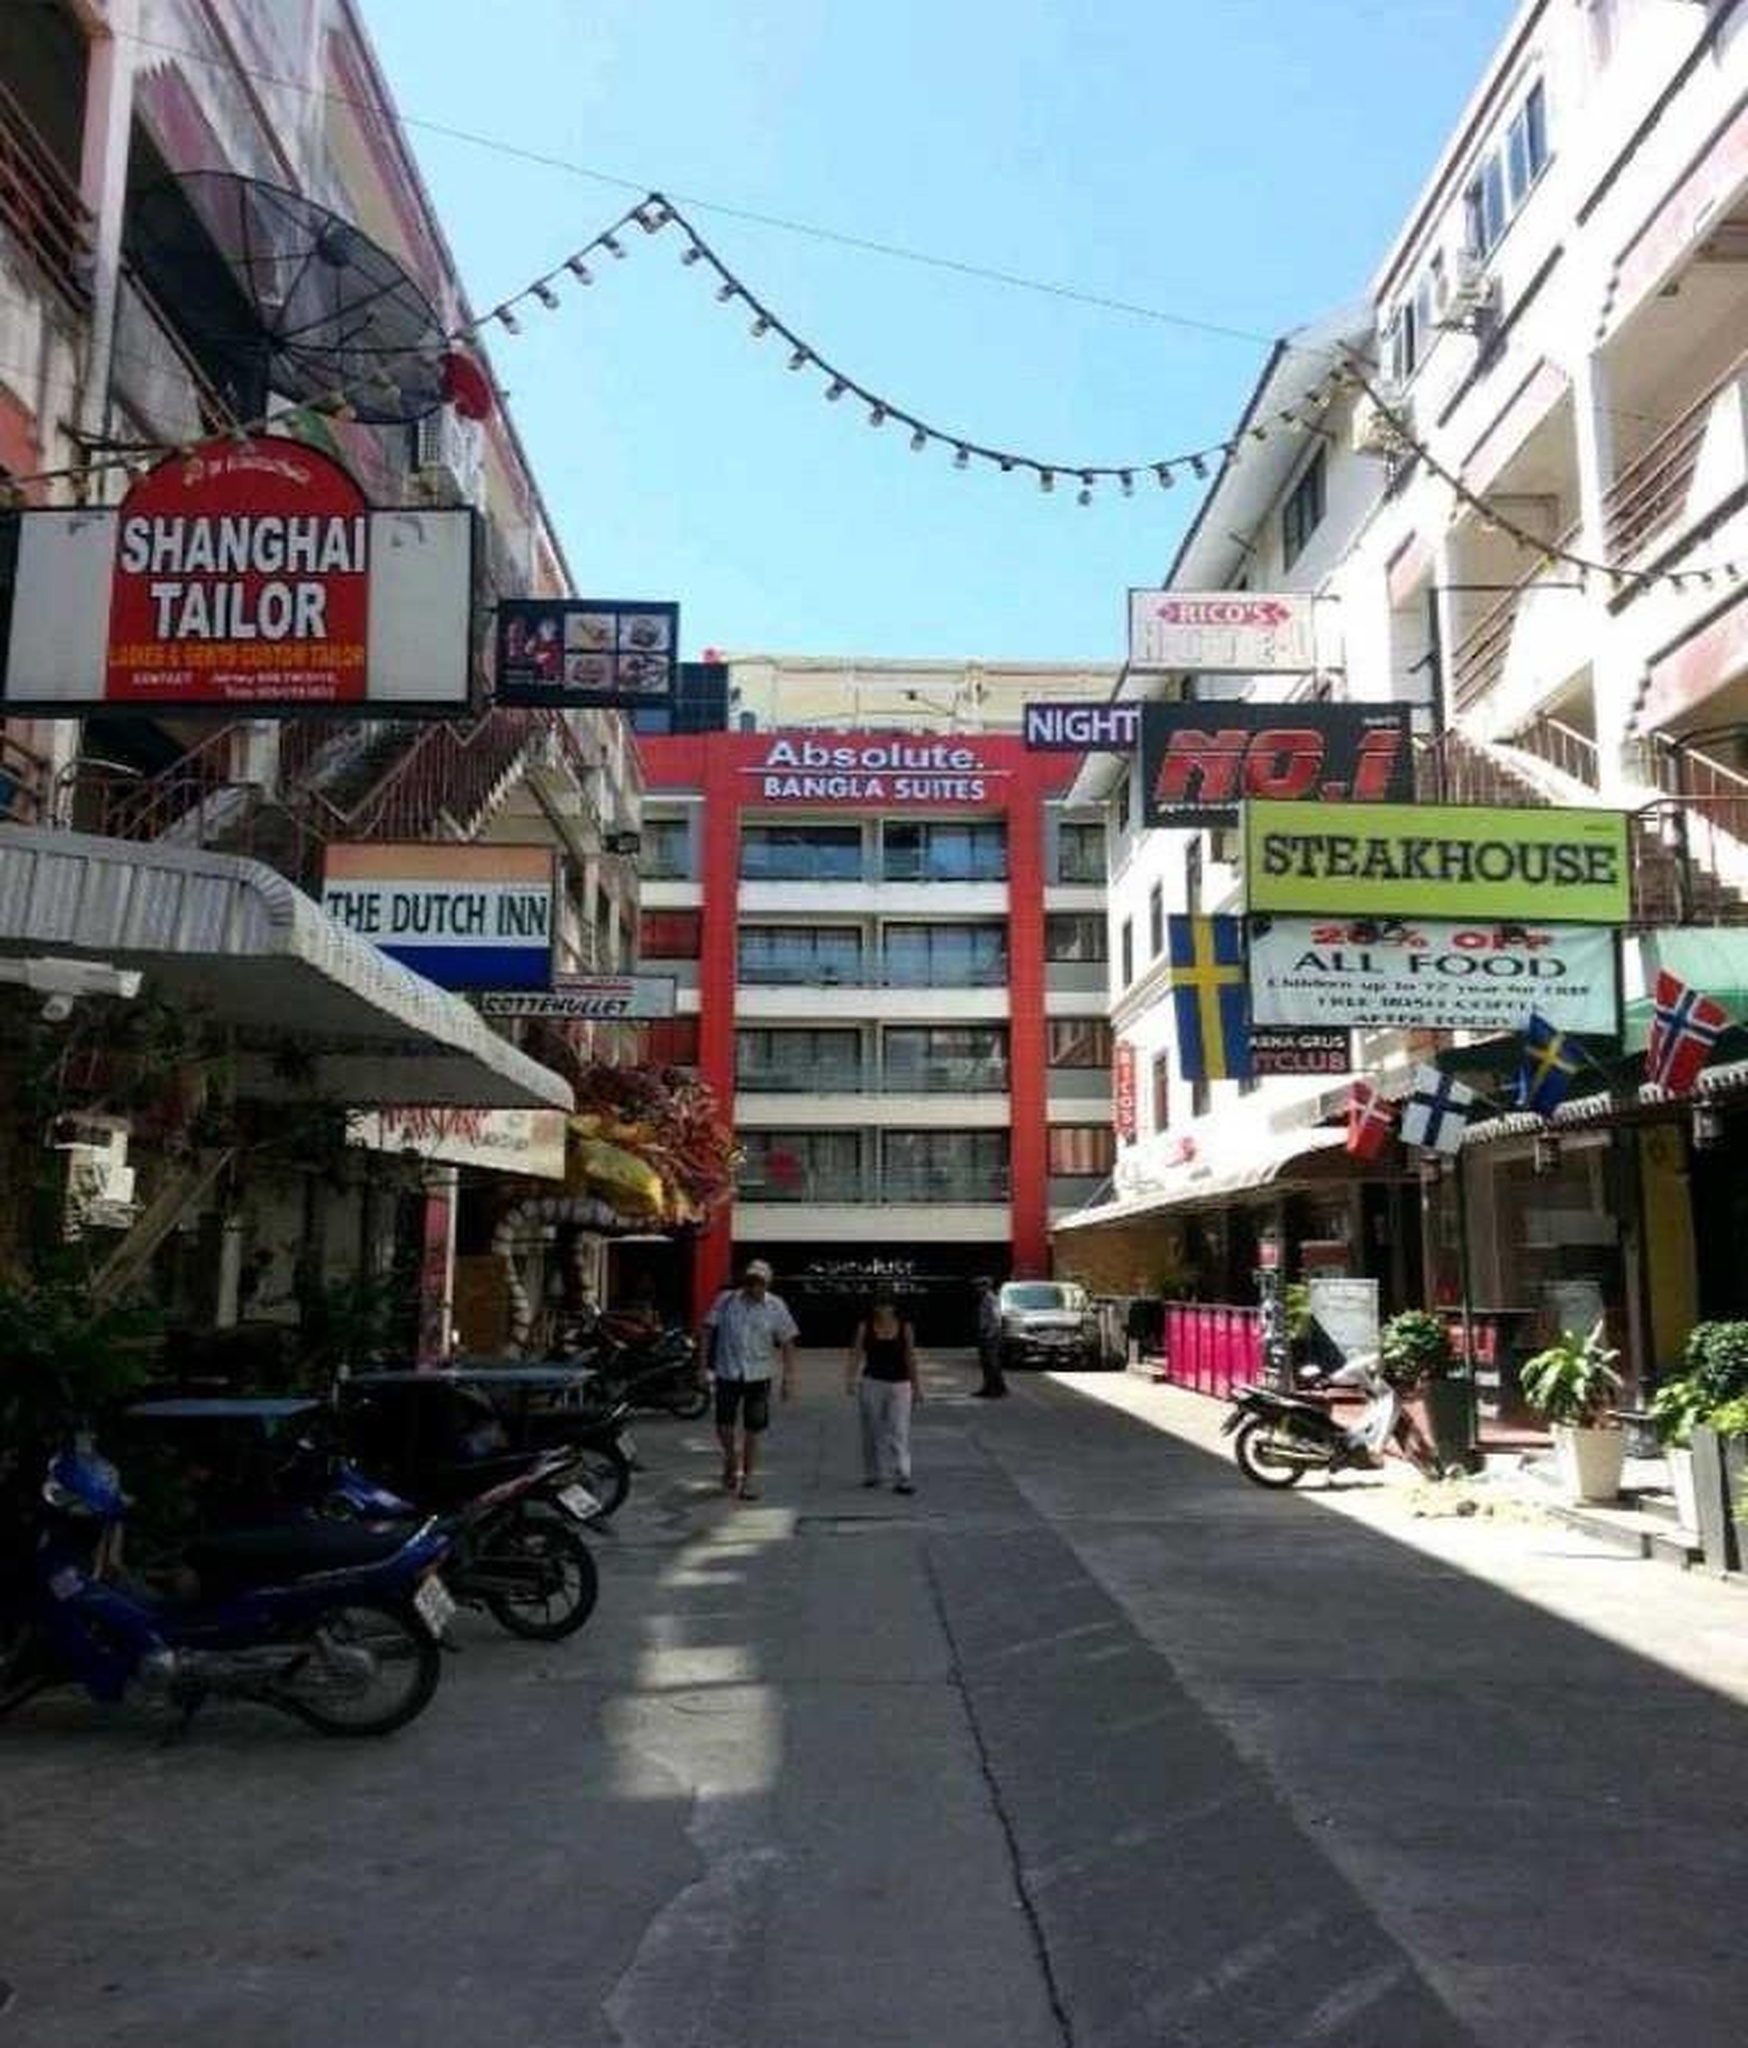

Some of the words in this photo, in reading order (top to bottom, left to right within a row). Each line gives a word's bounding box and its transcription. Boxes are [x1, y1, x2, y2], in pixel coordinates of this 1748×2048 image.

[120, 517, 365, 574] SHANGHAI
[150, 582, 327, 638] TAILOR
[1178, 602, 1270, 624] RICO'S
[1027, 707, 1142, 744] NIGHT
[763, 776, 885, 800] BANGLA
[894, 778, 985, 800] SUITES
[1263, 832, 1619, 887] STEAKHOUSE
[327, 890, 381, 932] THE
[391, 893, 486, 936] DUTCH
[499, 897, 547, 937] INN
[1293, 951, 1385, 974] ALL
[1409, 953, 1567, 979] FOOD
